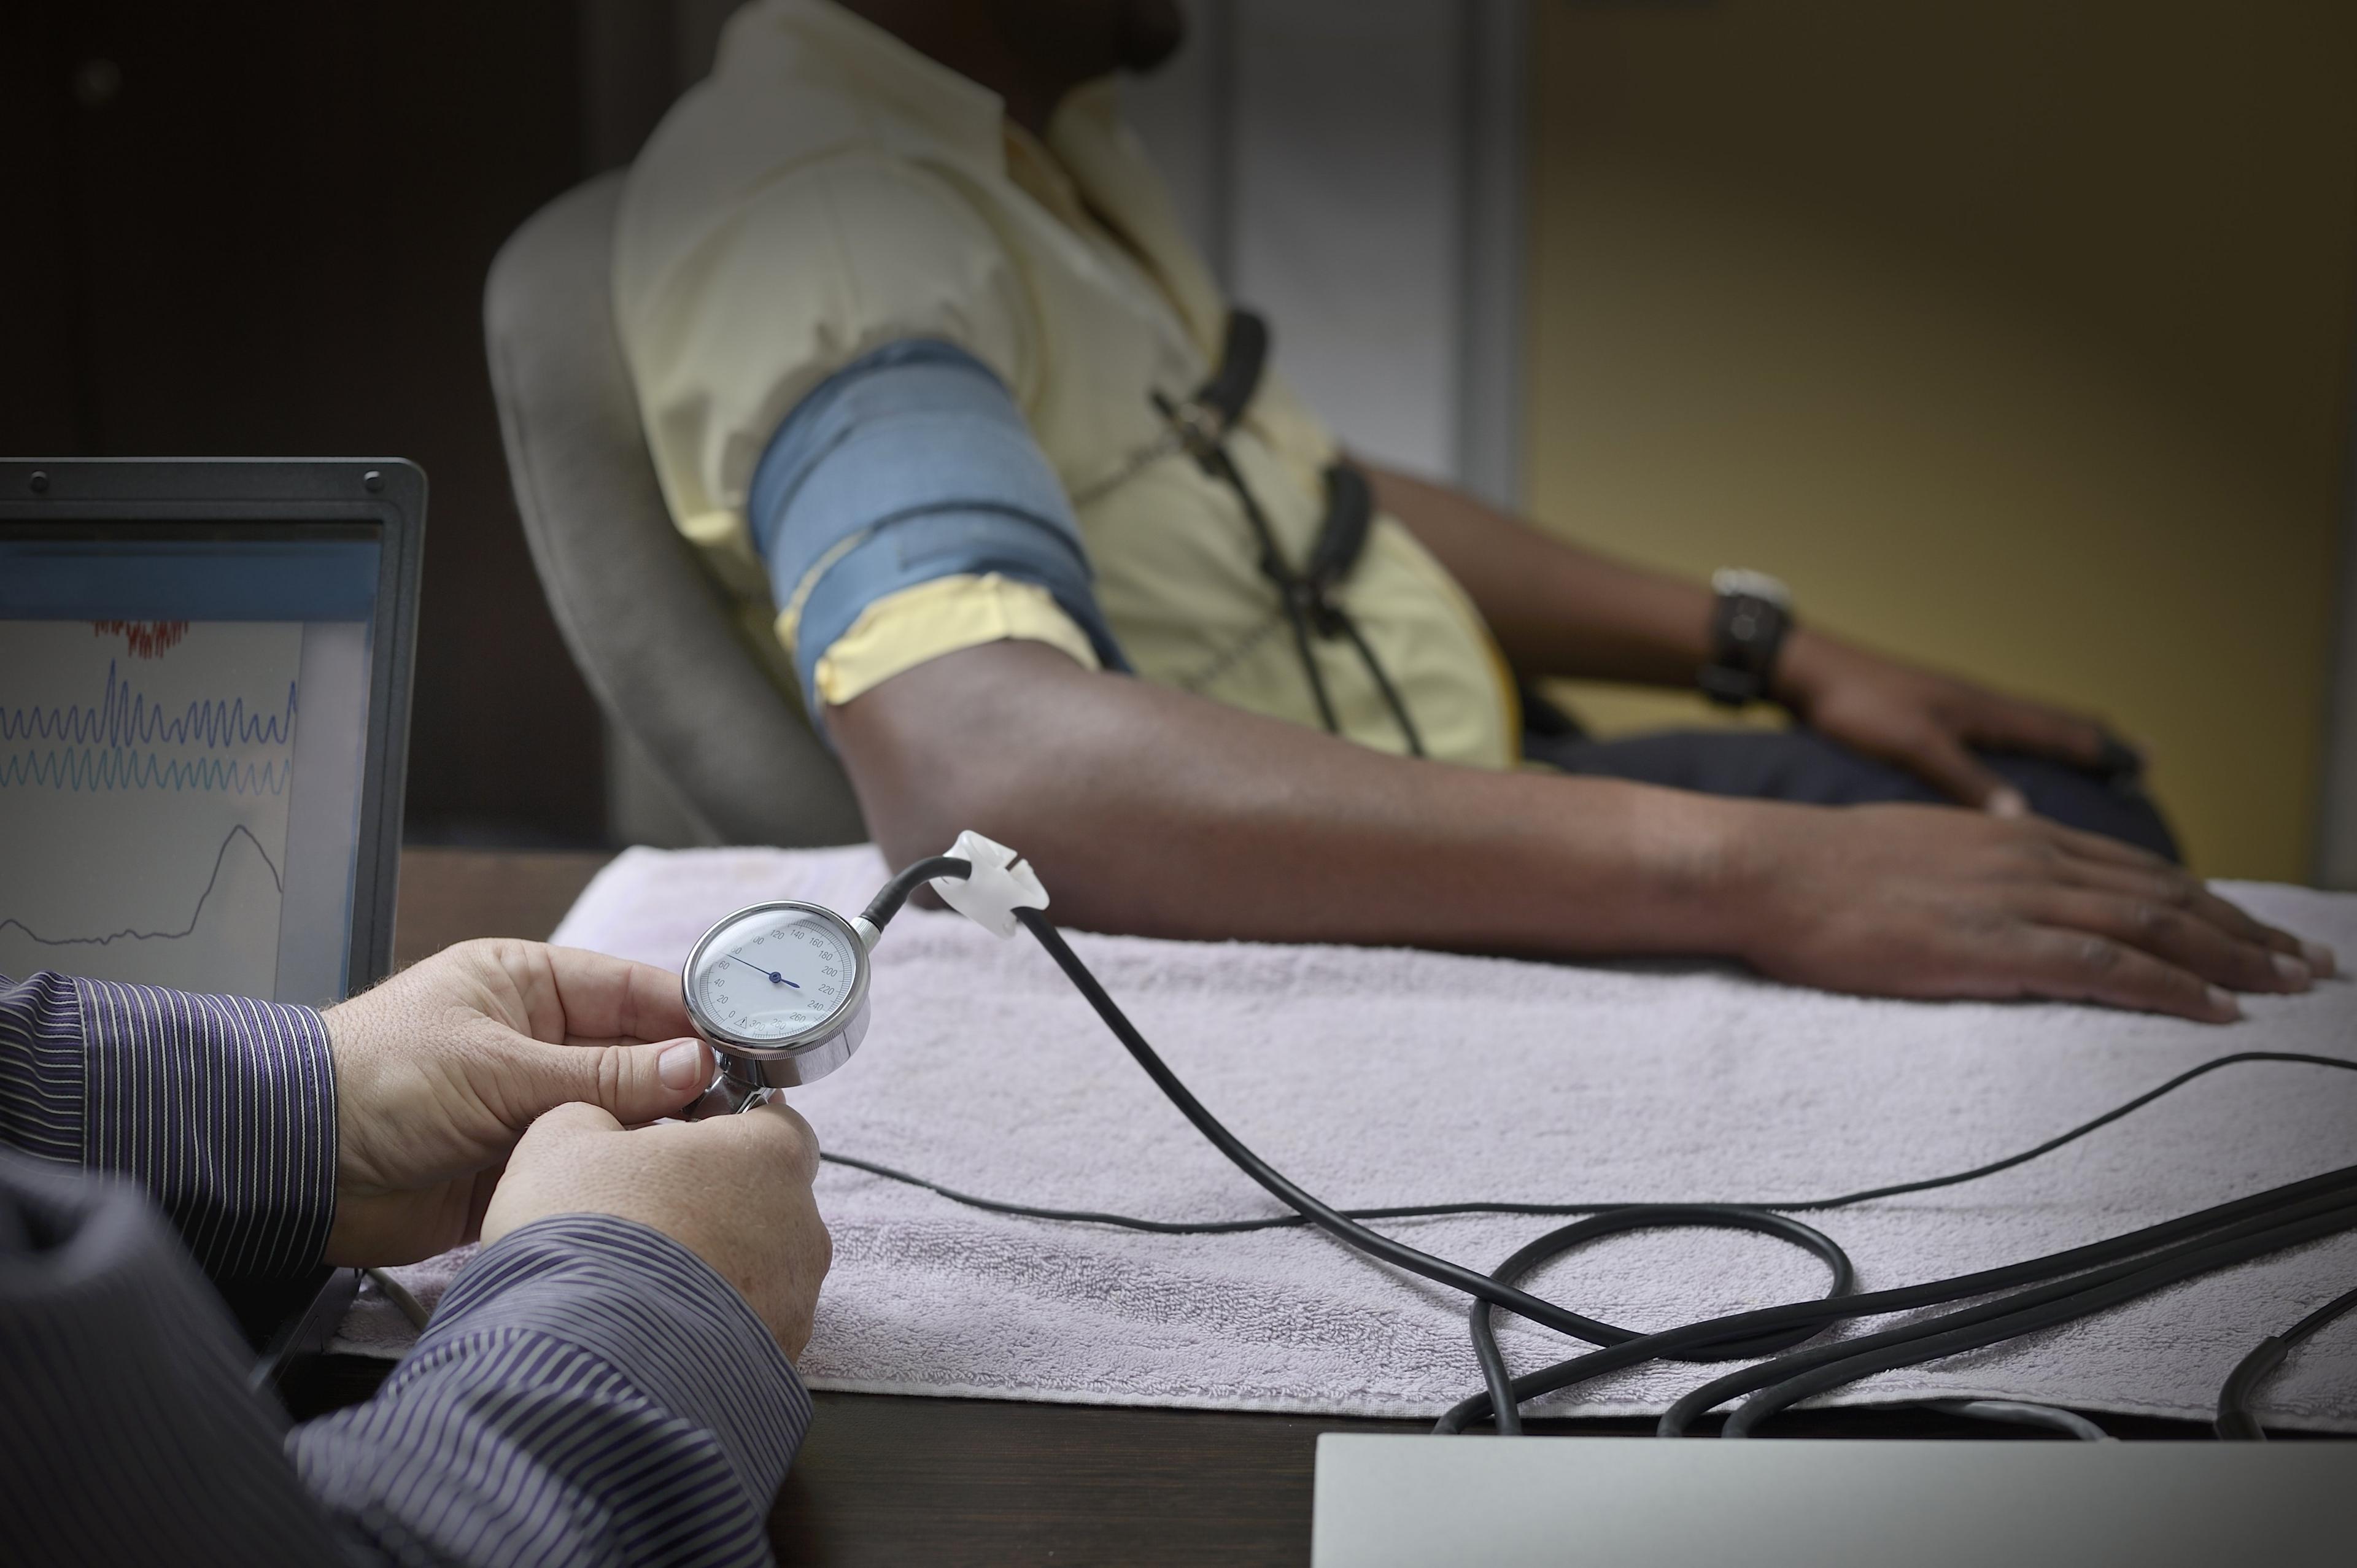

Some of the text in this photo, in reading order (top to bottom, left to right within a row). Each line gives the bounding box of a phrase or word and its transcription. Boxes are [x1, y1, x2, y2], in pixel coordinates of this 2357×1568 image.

[770, 929, 785, 940] 120
[790, 929, 805, 939] 140
[809, 937, 823, 948] 160
[818, 950, 833, 960] 180
[719, 960, 730, 970] 60
[822, 966, 838, 977] 200
[714, 978, 724, 987] 40
[818, 984, 834, 995] 220
[717, 995, 728, 1003] 20
[808, 1000, 824, 1011] 240
[789, 1012, 806, 1022] 260
[749, 1019, 765, 1031] 300
[770, 1018, 786, 1030] 280
